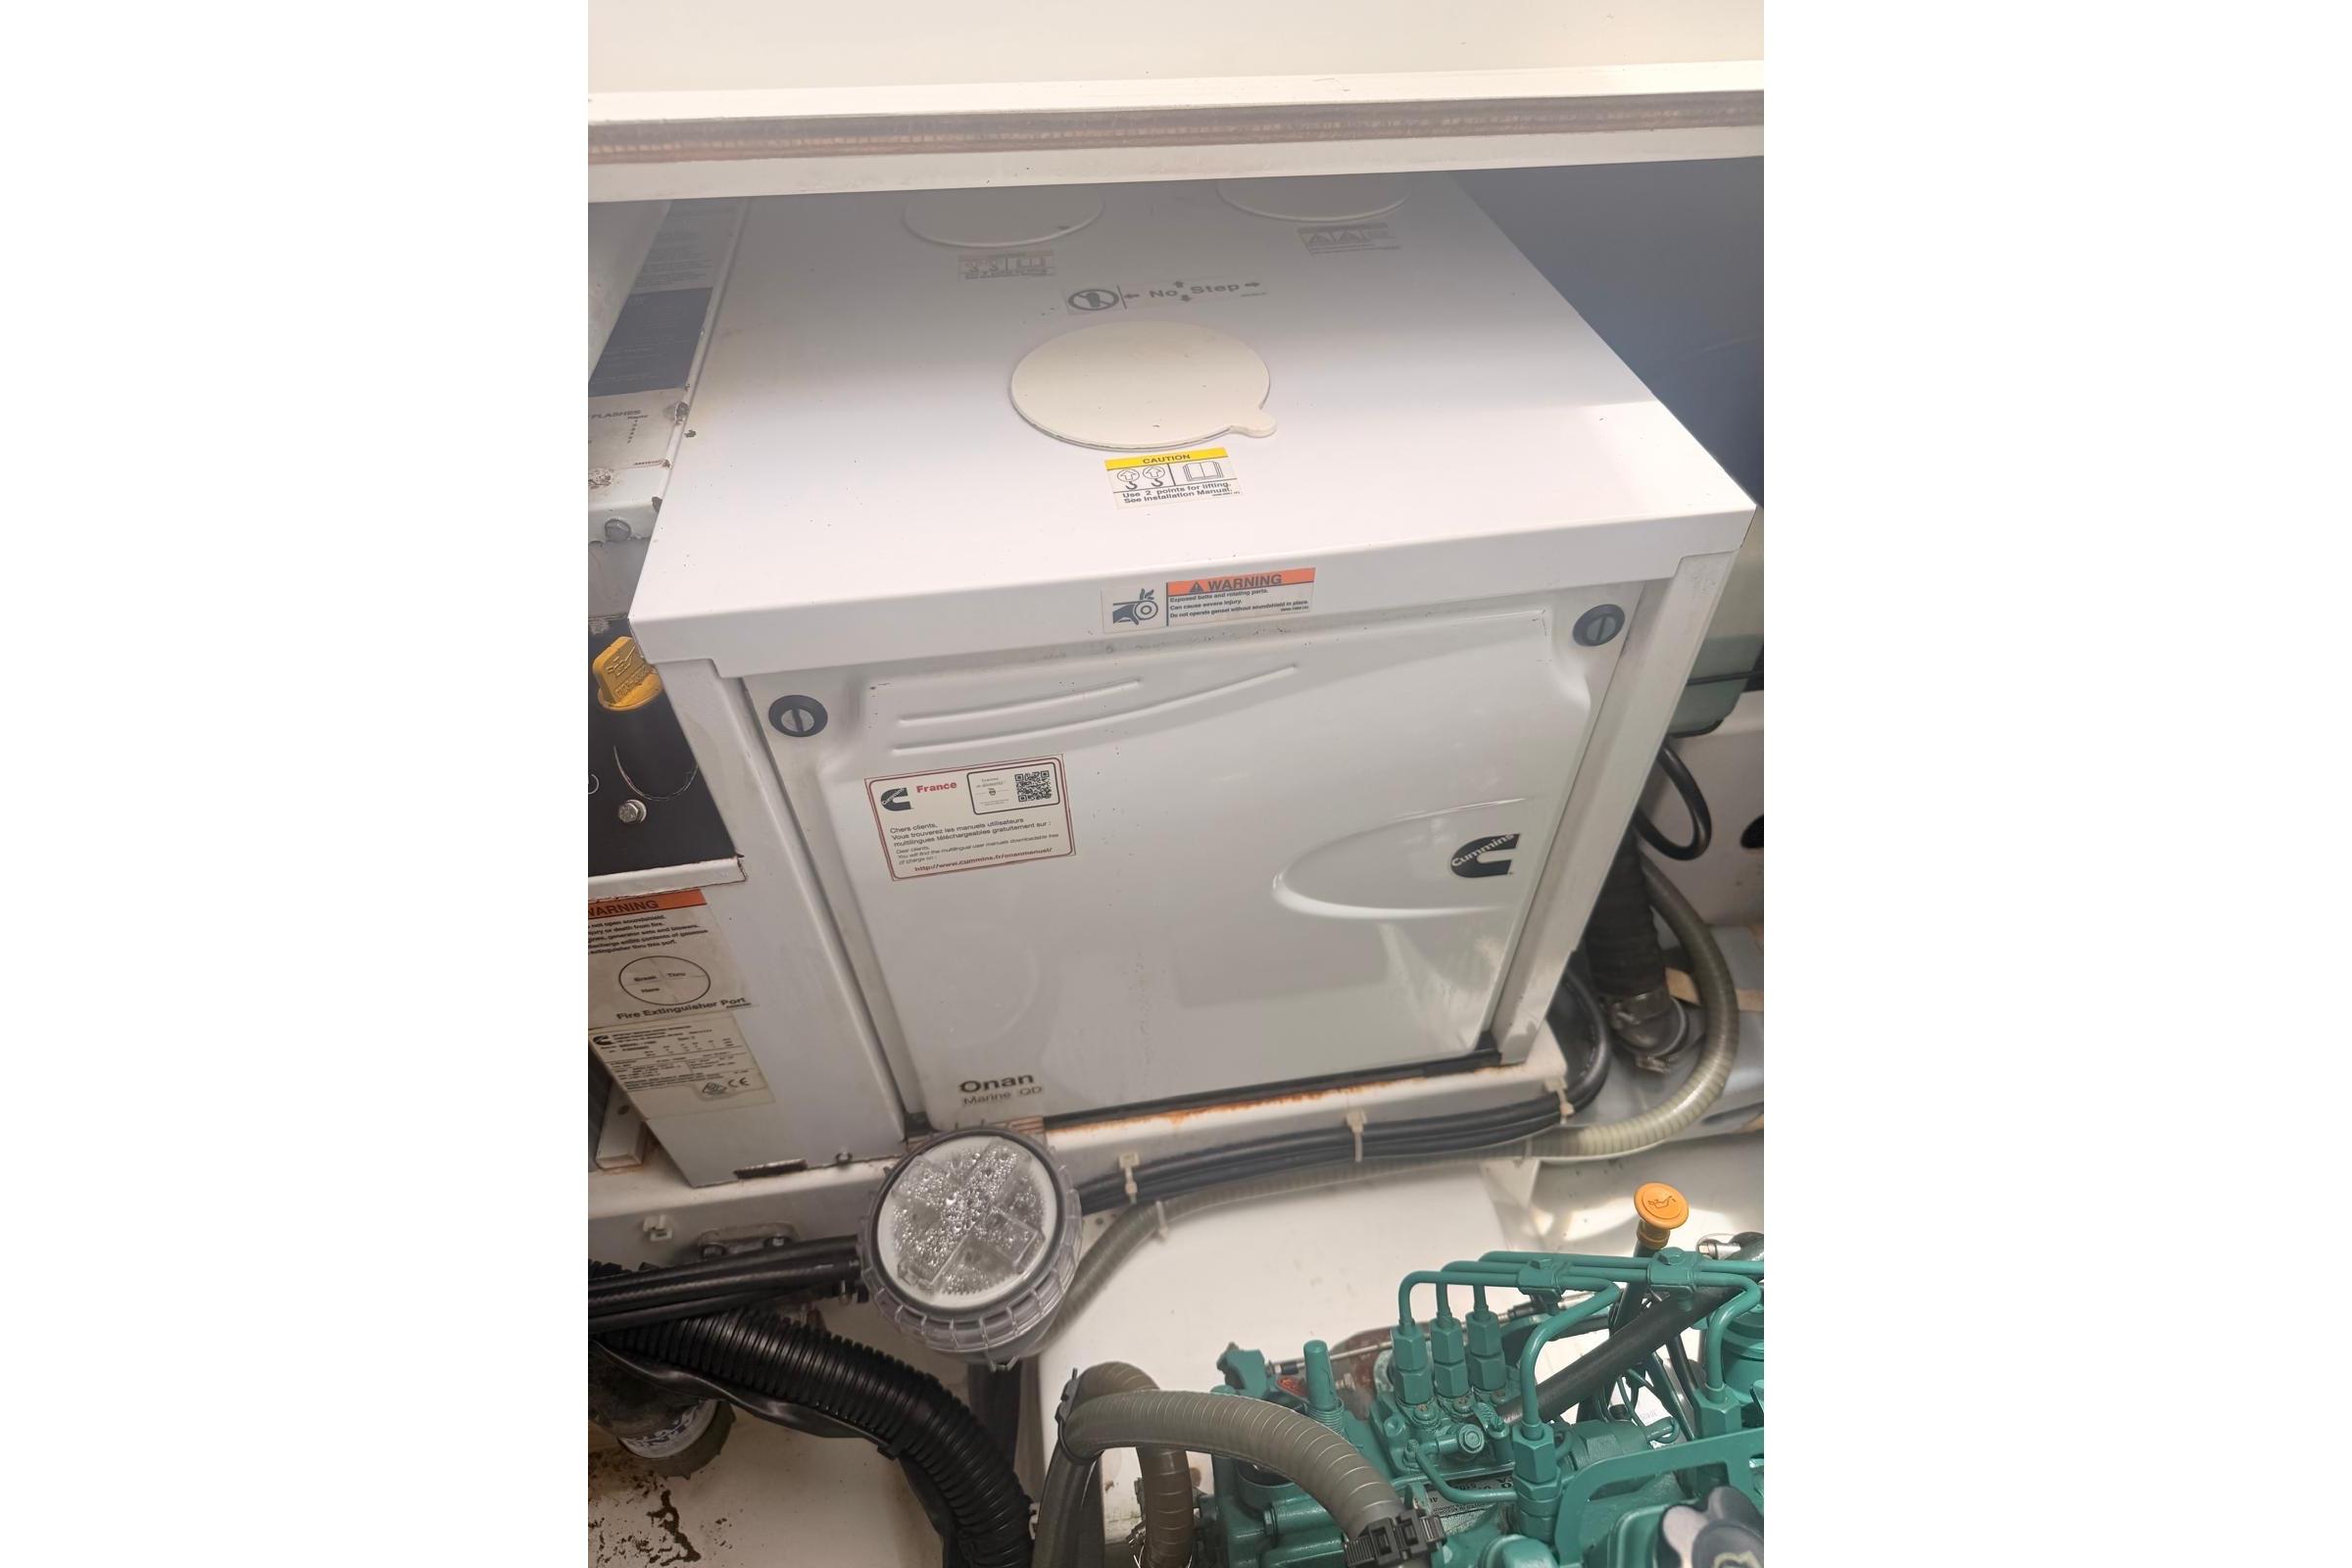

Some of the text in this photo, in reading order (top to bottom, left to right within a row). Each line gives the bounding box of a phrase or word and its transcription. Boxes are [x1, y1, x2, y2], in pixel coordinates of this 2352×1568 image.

[1149, 289, 1177, 299] No
[1190, 283, 1240, 295] Step
[1143, 454, 1191, 465] CAUTION
[1144, 492, 1195, 502] Installation
[1156, 487, 1186, 496] points
[1207, 573, 1282, 592] WARNING
[915, 782, 957, 794] France
[893, 837, 935, 848] multilingues
[992, 823, 1035, 835] gratuitement
[910, 829, 943, 838] trouverez
[956, 822, 986, 831] manuels
[987, 818, 1024, 827] utilisateurs
[1451, 834, 1514, 866] Cummins
[643, 1002, 717, 1016] Extinguisher
[720, 997, 746, 1006] Port
[728, 1077, 750, 1088] CE
[959, 1074, 1034, 1093] Onan
[963, 1086, 1043, 1105] Marine QD
